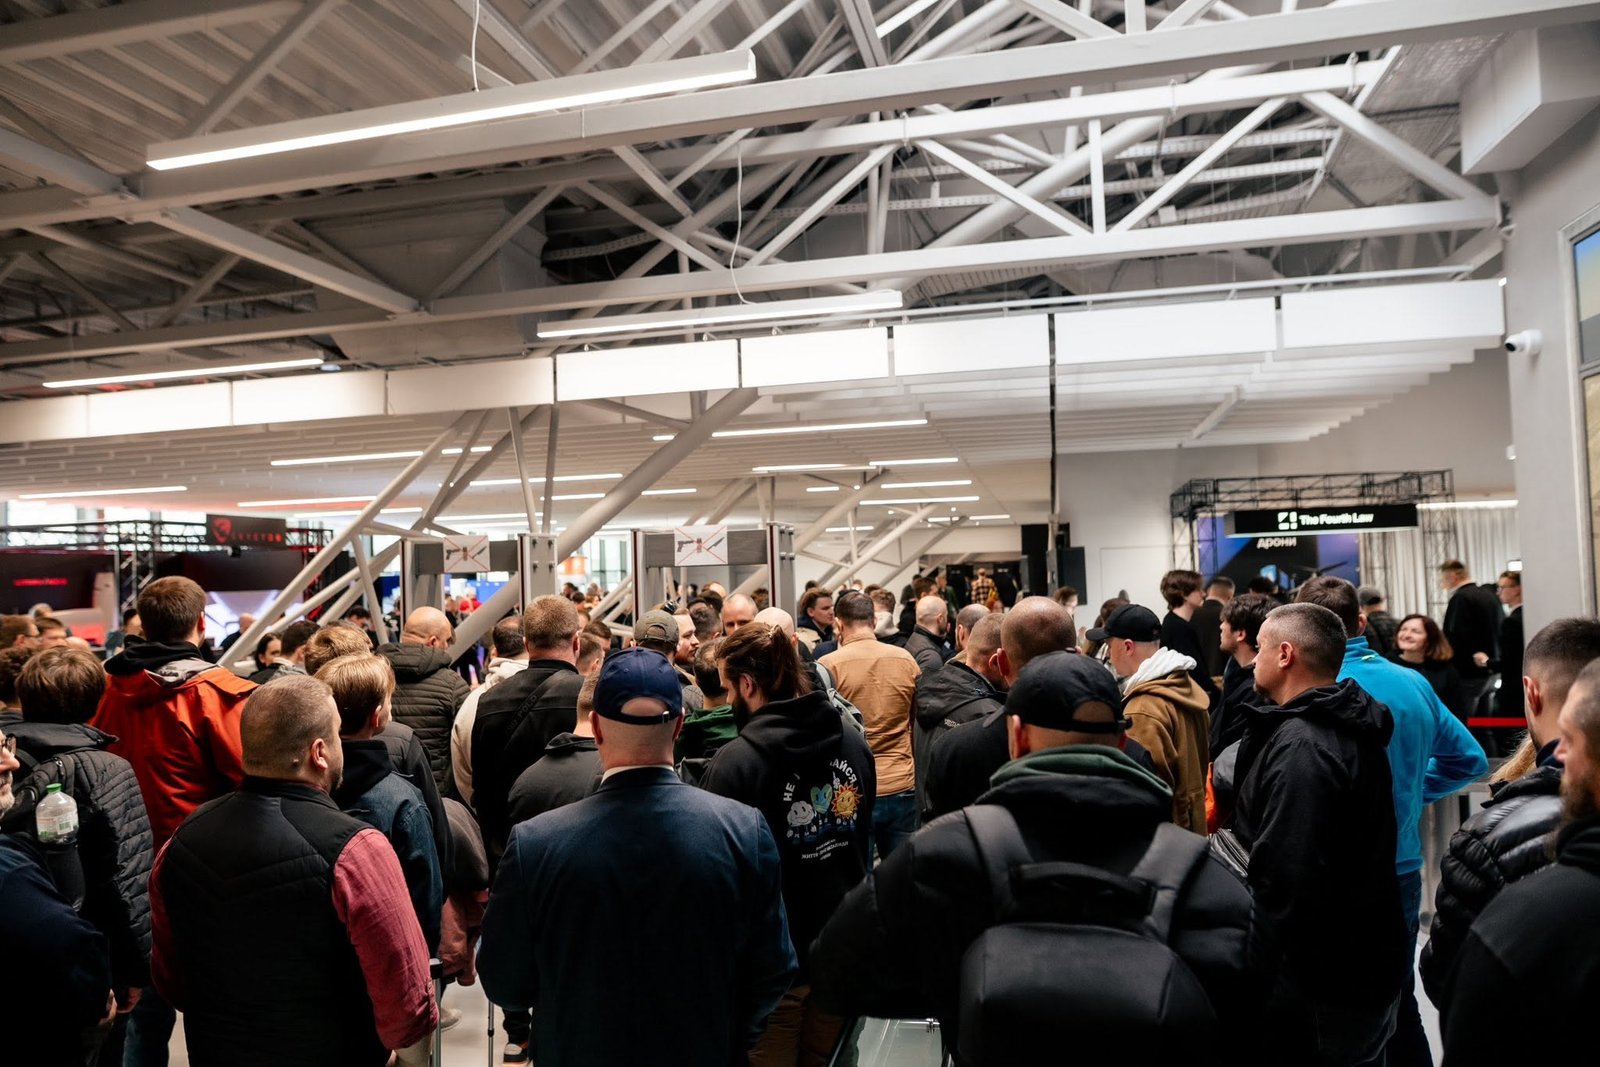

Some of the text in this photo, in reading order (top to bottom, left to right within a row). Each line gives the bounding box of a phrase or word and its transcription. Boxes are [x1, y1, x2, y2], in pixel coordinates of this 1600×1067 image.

[1300, 512, 1374, 526] The Fourth Law
